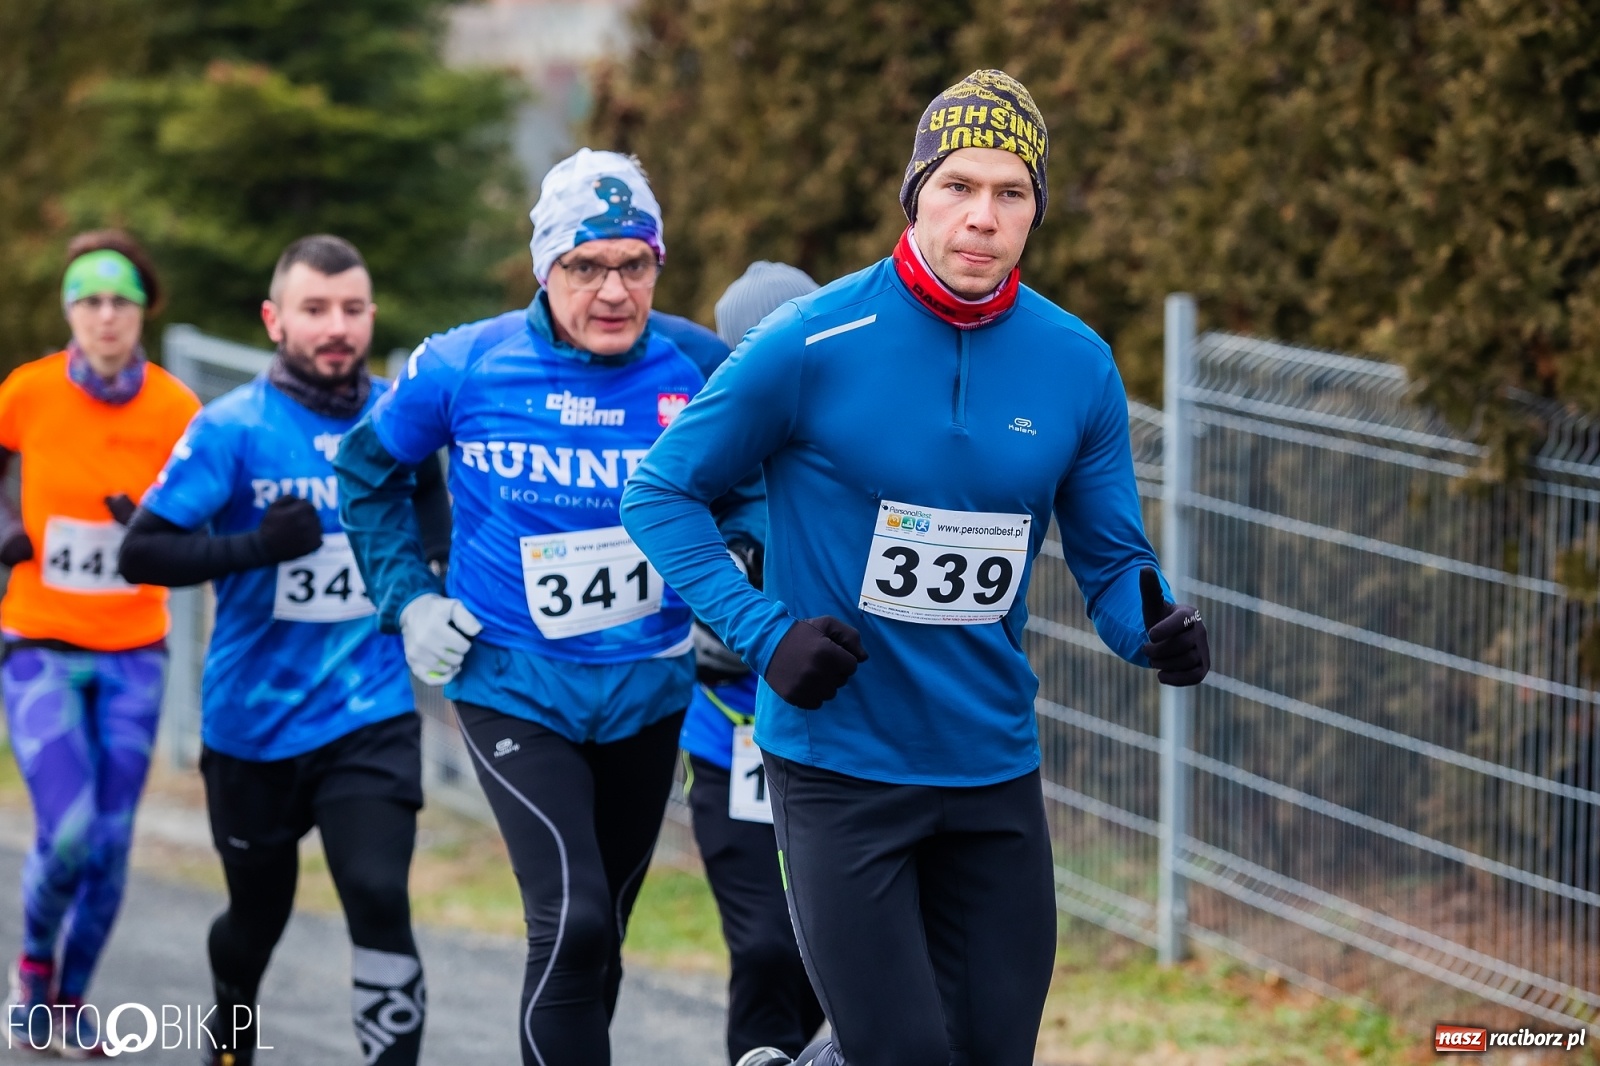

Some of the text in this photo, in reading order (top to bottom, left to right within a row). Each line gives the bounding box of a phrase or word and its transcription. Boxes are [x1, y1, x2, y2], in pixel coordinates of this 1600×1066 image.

[929, 105, 1046, 156] FINISHER
[937, 523, 1024, 539] www.personalbest.pl
[50, 544, 122, 579] 44
[875, 546, 1013, 606] 339
[287, 567, 368, 604] 34
[536, 561, 649, 617] 341
